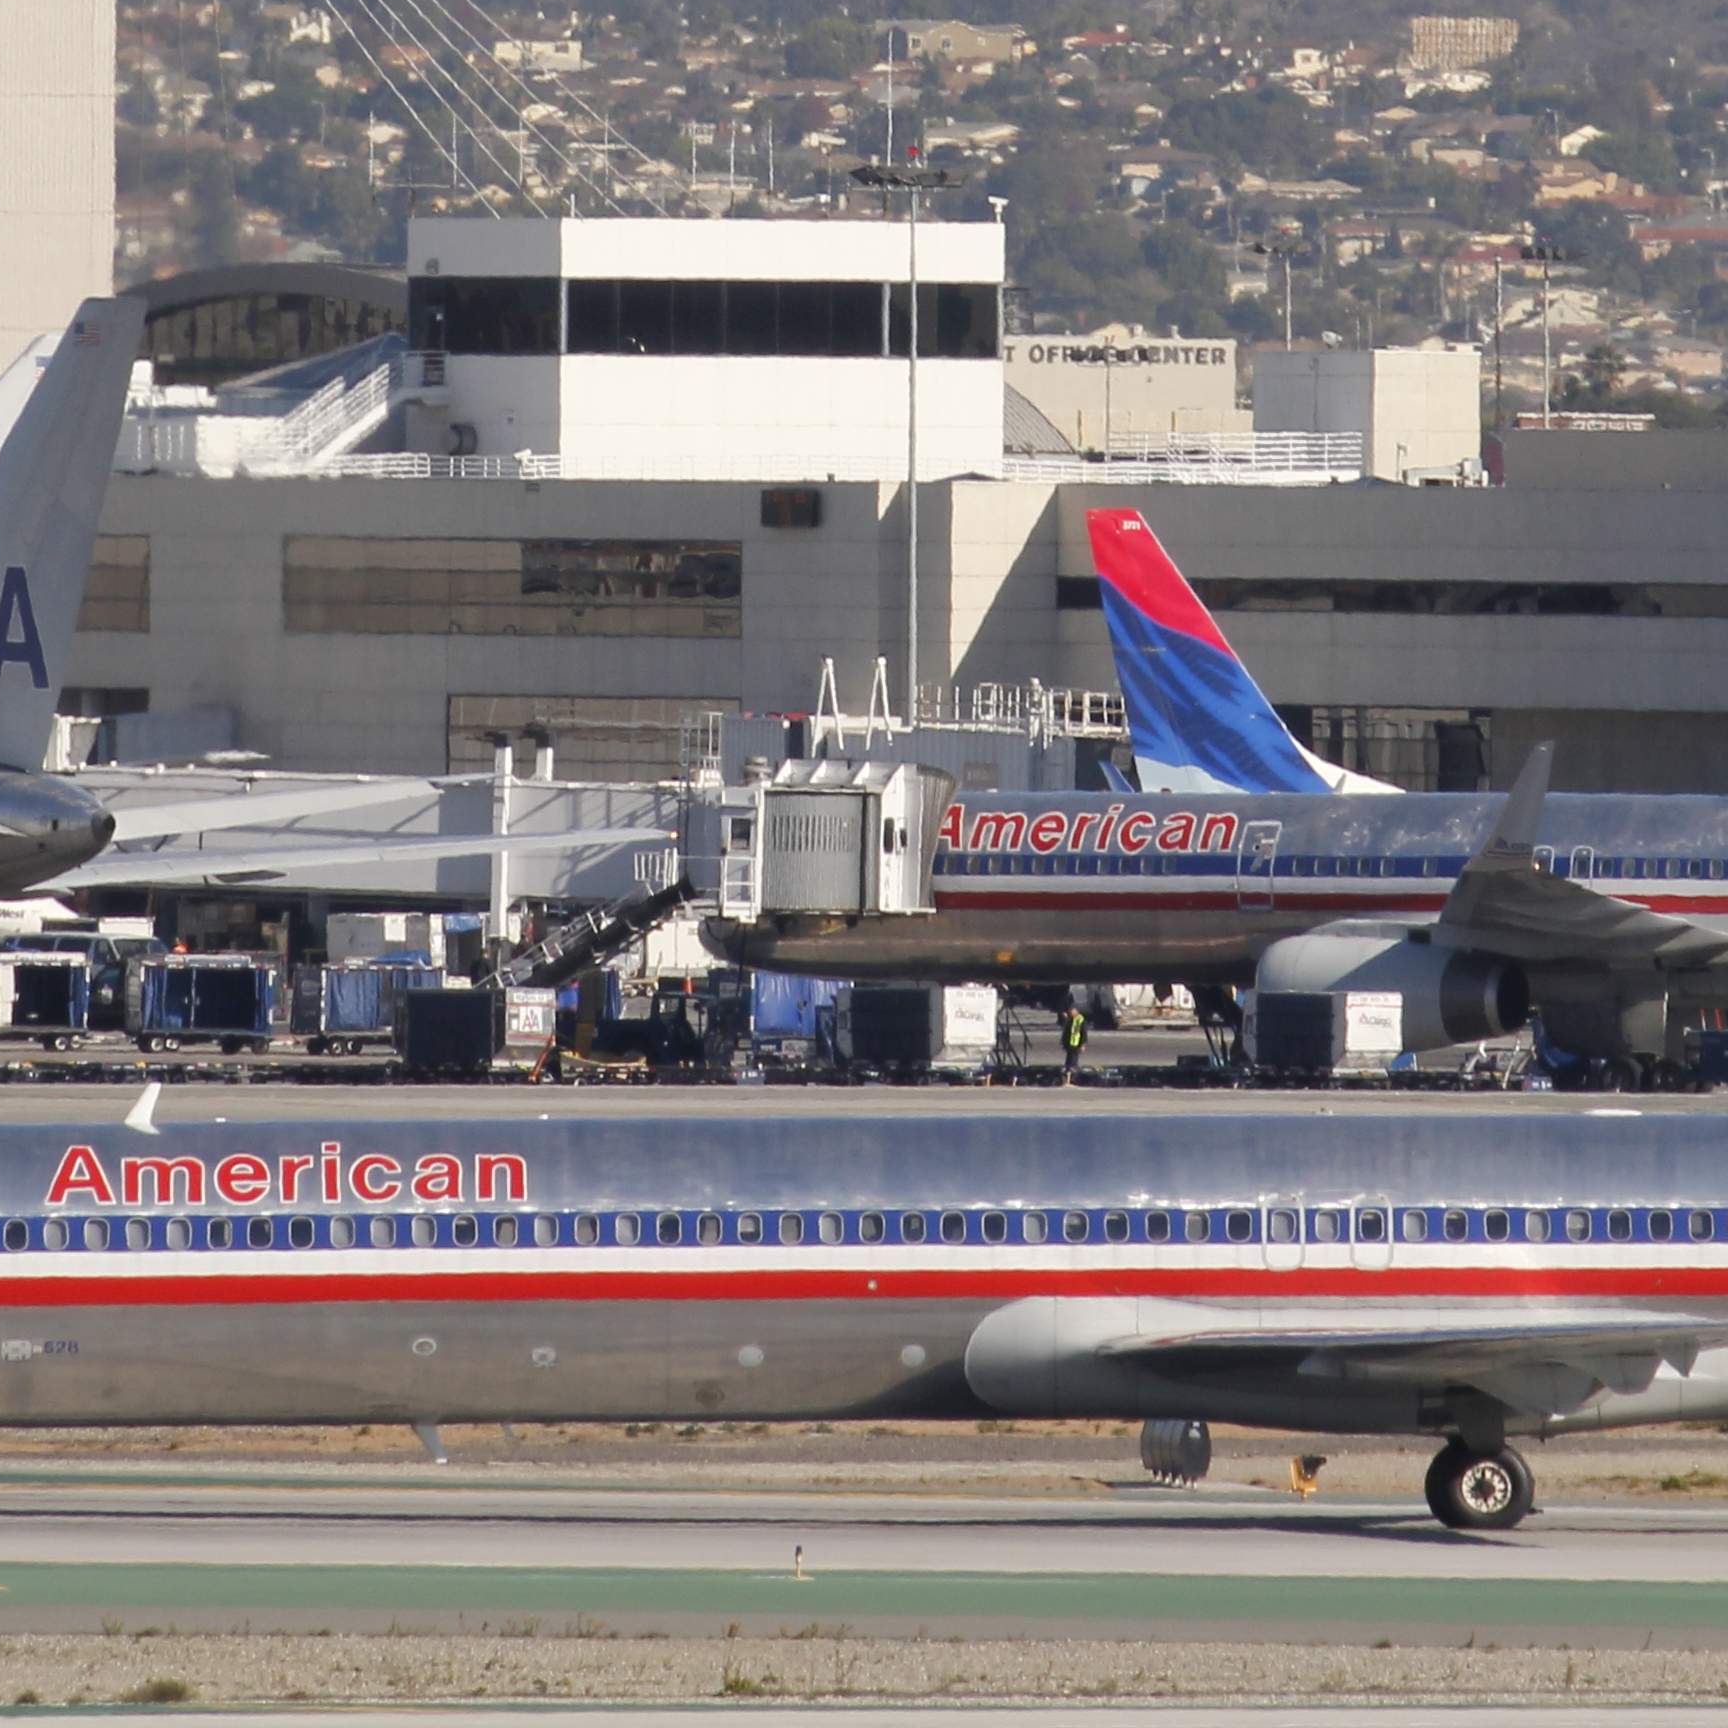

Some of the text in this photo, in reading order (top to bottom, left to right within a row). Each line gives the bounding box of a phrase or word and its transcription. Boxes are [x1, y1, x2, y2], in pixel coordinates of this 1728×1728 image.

[1029, 344, 1118, 364] OFFCE
[939, 803, 1239, 854] American
[44, 1140, 529, 1206] American
